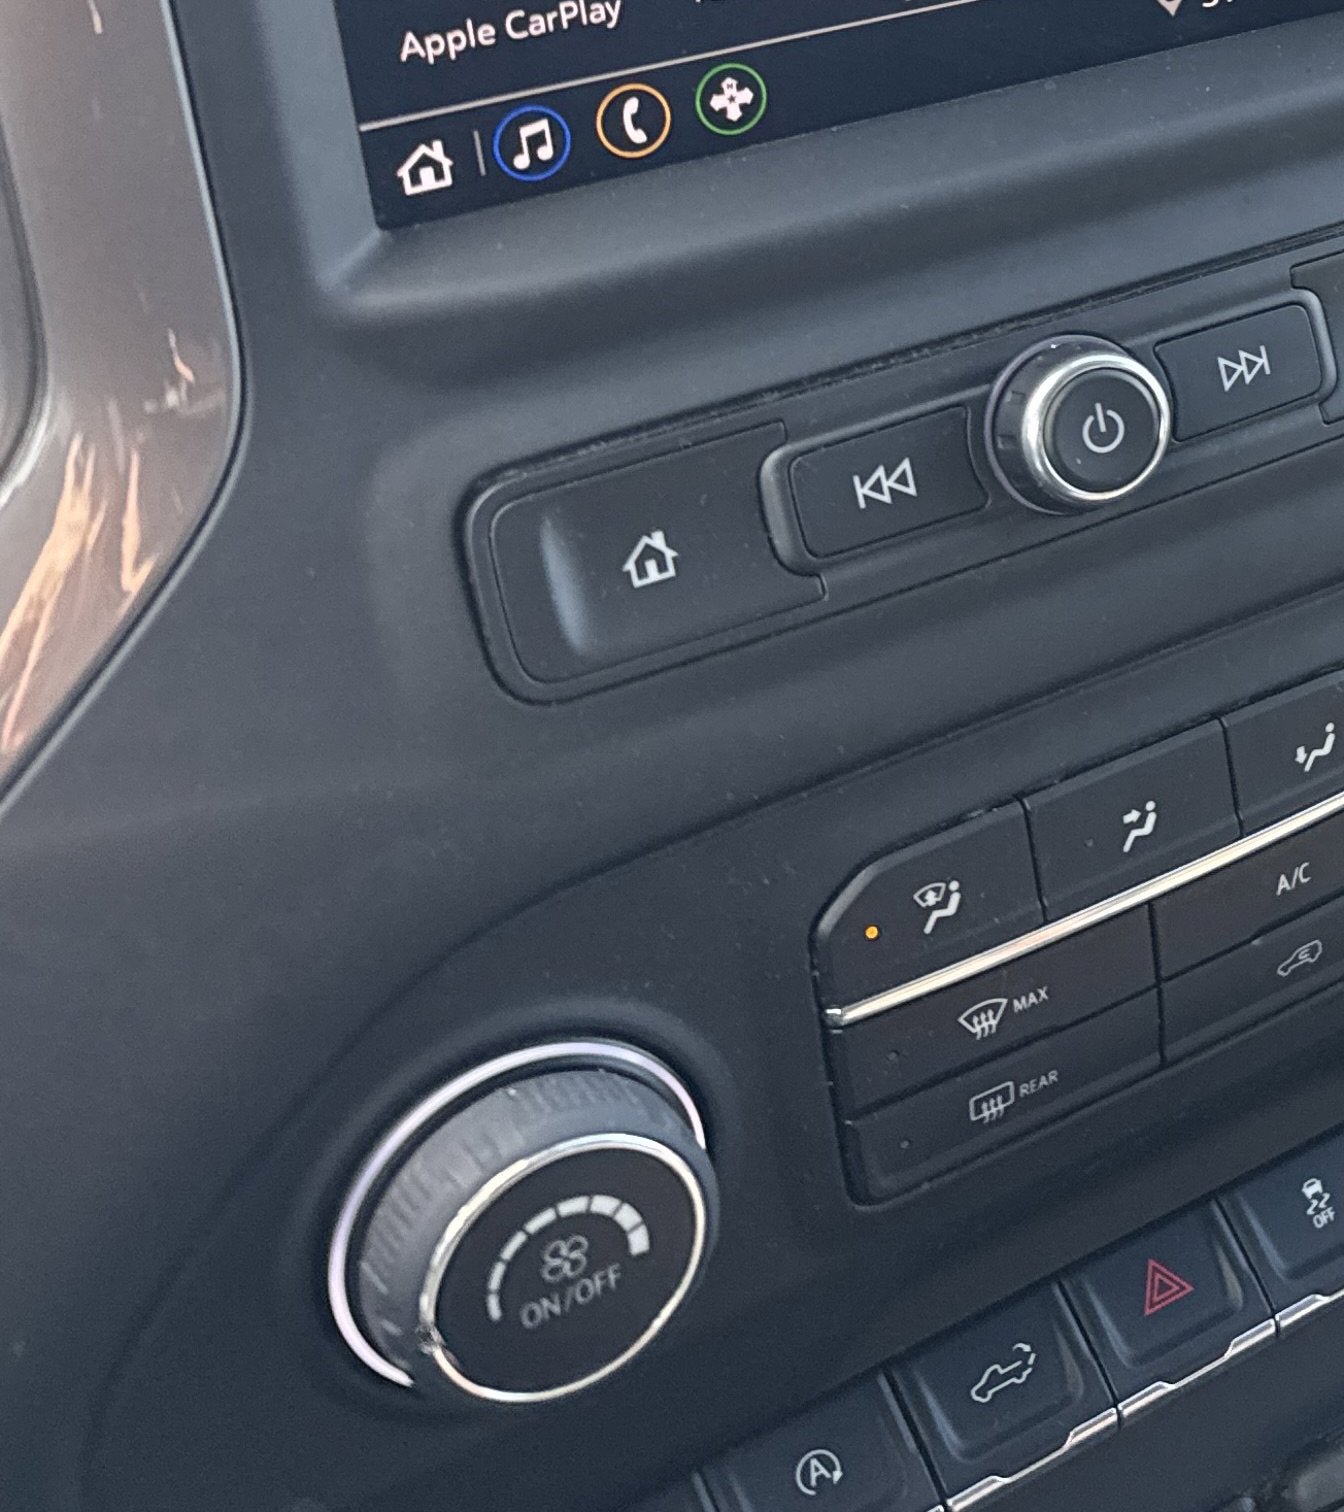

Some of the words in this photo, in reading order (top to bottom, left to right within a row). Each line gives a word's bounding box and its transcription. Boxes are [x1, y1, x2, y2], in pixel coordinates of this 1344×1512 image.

[400, 20, 497, 64] Apple
[1275, 862, 1310, 896] A/C
[1012, 986, 1049, 1015] MAX
[1019, 1069, 1059, 1100] REAR
[1312, 1206, 1336, 1229] OFF
[520, 1262, 623, 1330] ON/OFF
